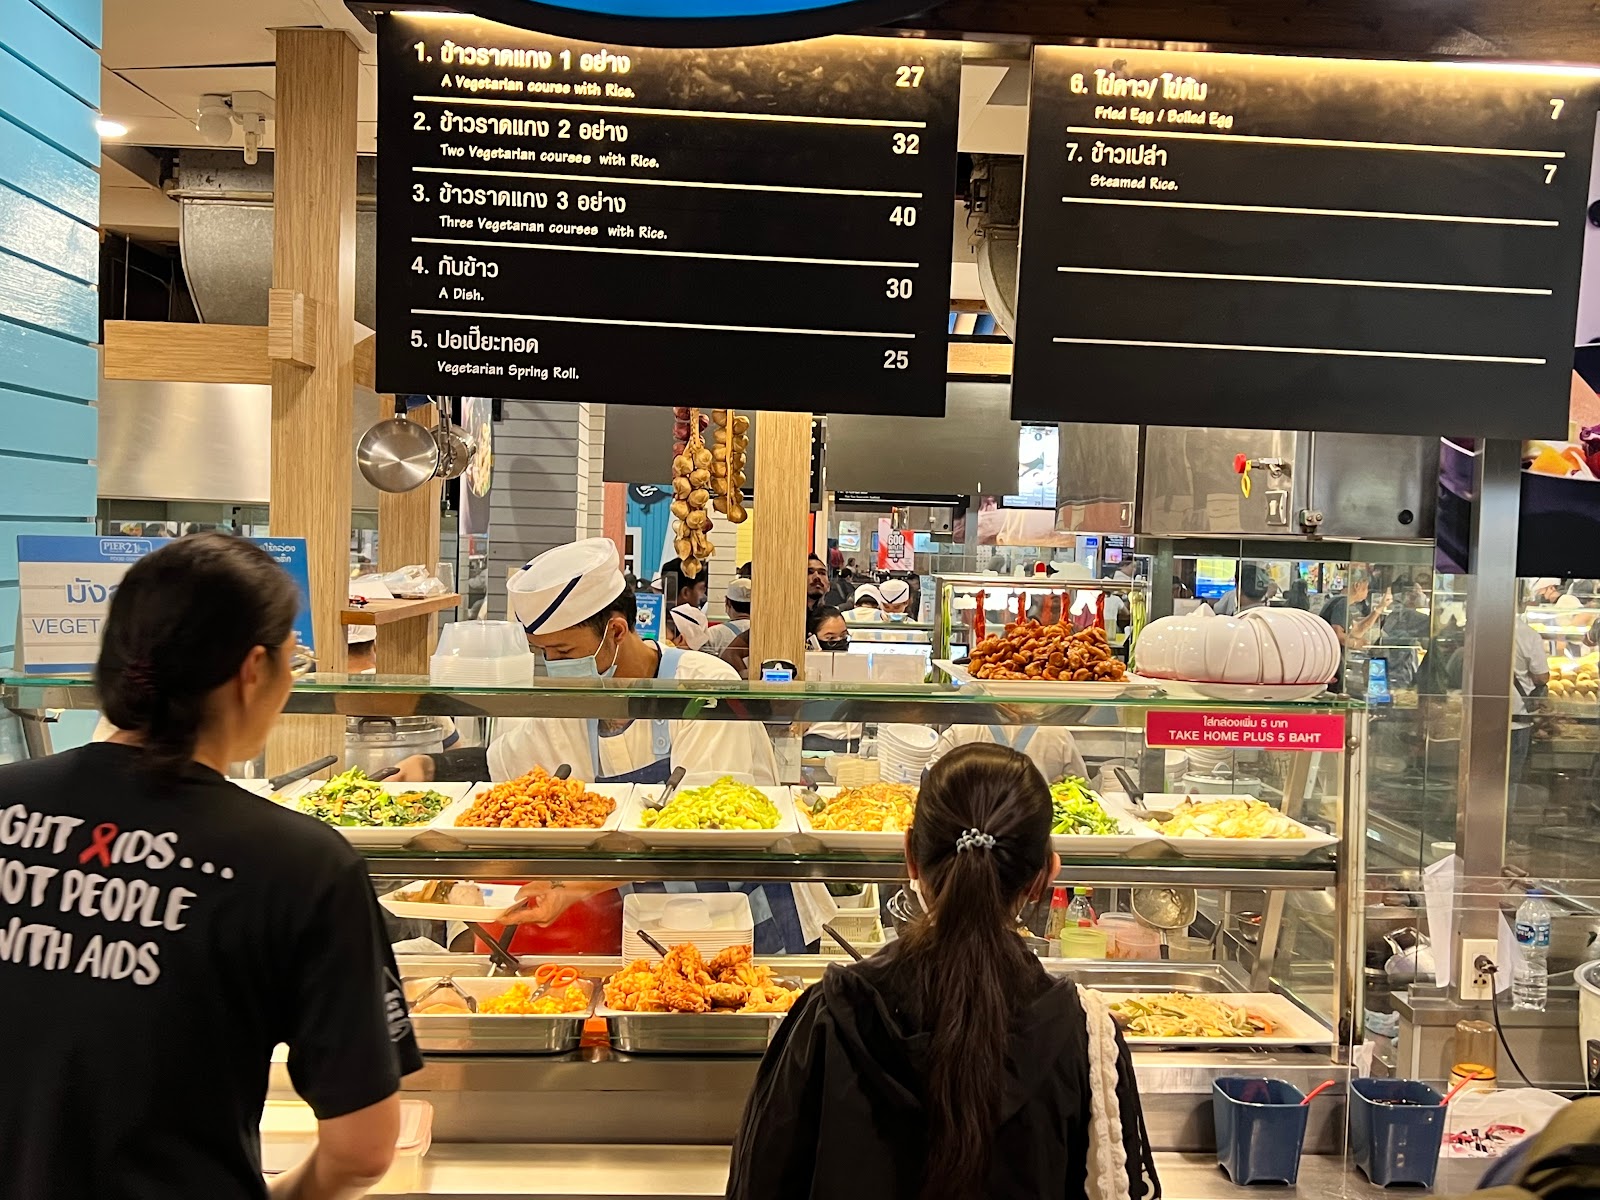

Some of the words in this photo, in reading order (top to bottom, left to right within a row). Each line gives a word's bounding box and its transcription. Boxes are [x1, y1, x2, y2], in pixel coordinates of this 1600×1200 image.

[414, 42, 432, 62] 1.
[440, 40, 552, 69] ข้าวราดแกง
[559, 50, 571, 70] 1
[580, 49, 631, 74] อย่าง
[441, 74, 452, 87] A
[455, 75, 523, 91] Vegetarian
[527, 80, 571, 94] course
[574, 81, 601, 96] with
[605, 83, 635, 98] Rice.
[896, 66, 924, 88] 27
[1071, 74, 1089, 94] 6.
[1095, 106, 1126, 120] Fried
[1130, 108, 1154, 124] Egg
[1157, 109, 1164, 122] /
[1168, 110, 1205, 124] Boiled
[1209, 112, 1233, 128] Egg
[1549, 99, 1564, 120] 7
[413, 112, 431, 131] 2.
[440, 110, 549, 137] ข้าวราดแกง
[558, 119, 571, 138] 2
[579, 119, 628, 142] อย่าง
[893, 133, 919, 155] 32
[1066, 143, 1083, 162] 7.
[1091, 141, 1167, 166] ข้าวเปล่า
[440, 143, 465, 157] Two
[468, 145, 535, 161] Vegetarian
[540, 152, 591, 164] courses
[600, 152, 625, 166] with
[631, 154, 660, 168] Rice.
[1090, 174, 1146, 189] Steamed
[1150, 177, 1178, 191] Rice.
[1543, 164, 1558, 184] 7
[413, 184, 430, 203] 3.
[439, 182, 547, 209] ข้าวราดแกง
[556, 191, 569, 210] 3
[577, 191, 626, 214] อย่าง
[439, 215, 473, 230] Three
[478, 216, 545, 232] Vegetarian
[549, 223, 598, 236] courses
[608, 225, 634, 238] with
[639, 226, 667, 239] Rice.
[890, 206, 917, 227] 40
[411, 256, 429, 275] 4.
[438, 255, 498, 278] กับข้าว
[439, 287, 448, 299] A
[453, 288, 484, 301] Dish.
[886, 278, 913, 299] 30
[411, 330, 427, 348] 5.
[437, 326, 538, 354] ปอเปี๊ยะทอด
[437, 361, 503, 376] Vegetarian
[509, 364, 548, 381] Spring
[553, 367, 579, 380] Roll.
[884, 350, 909, 370] 25
[888, 535, 904, 545] 600
[31, 618, 101, 634] VEGET
[1261, 718, 1267, 728] 5
[1270, 720, 1288, 729] บาท
[1169, 730, 1199, 741] TAKE
[1204, 731, 1239, 742] HOME
[1243, 731, 1274, 742] PLUS
[1278, 732, 1285, 743] 5
[1289, 732, 1321, 743] BAHT
[0, 804, 85, 854] GHT
[60, 869, 197, 931] PEOPLE
[74, 934, 160, 985] AIDS
